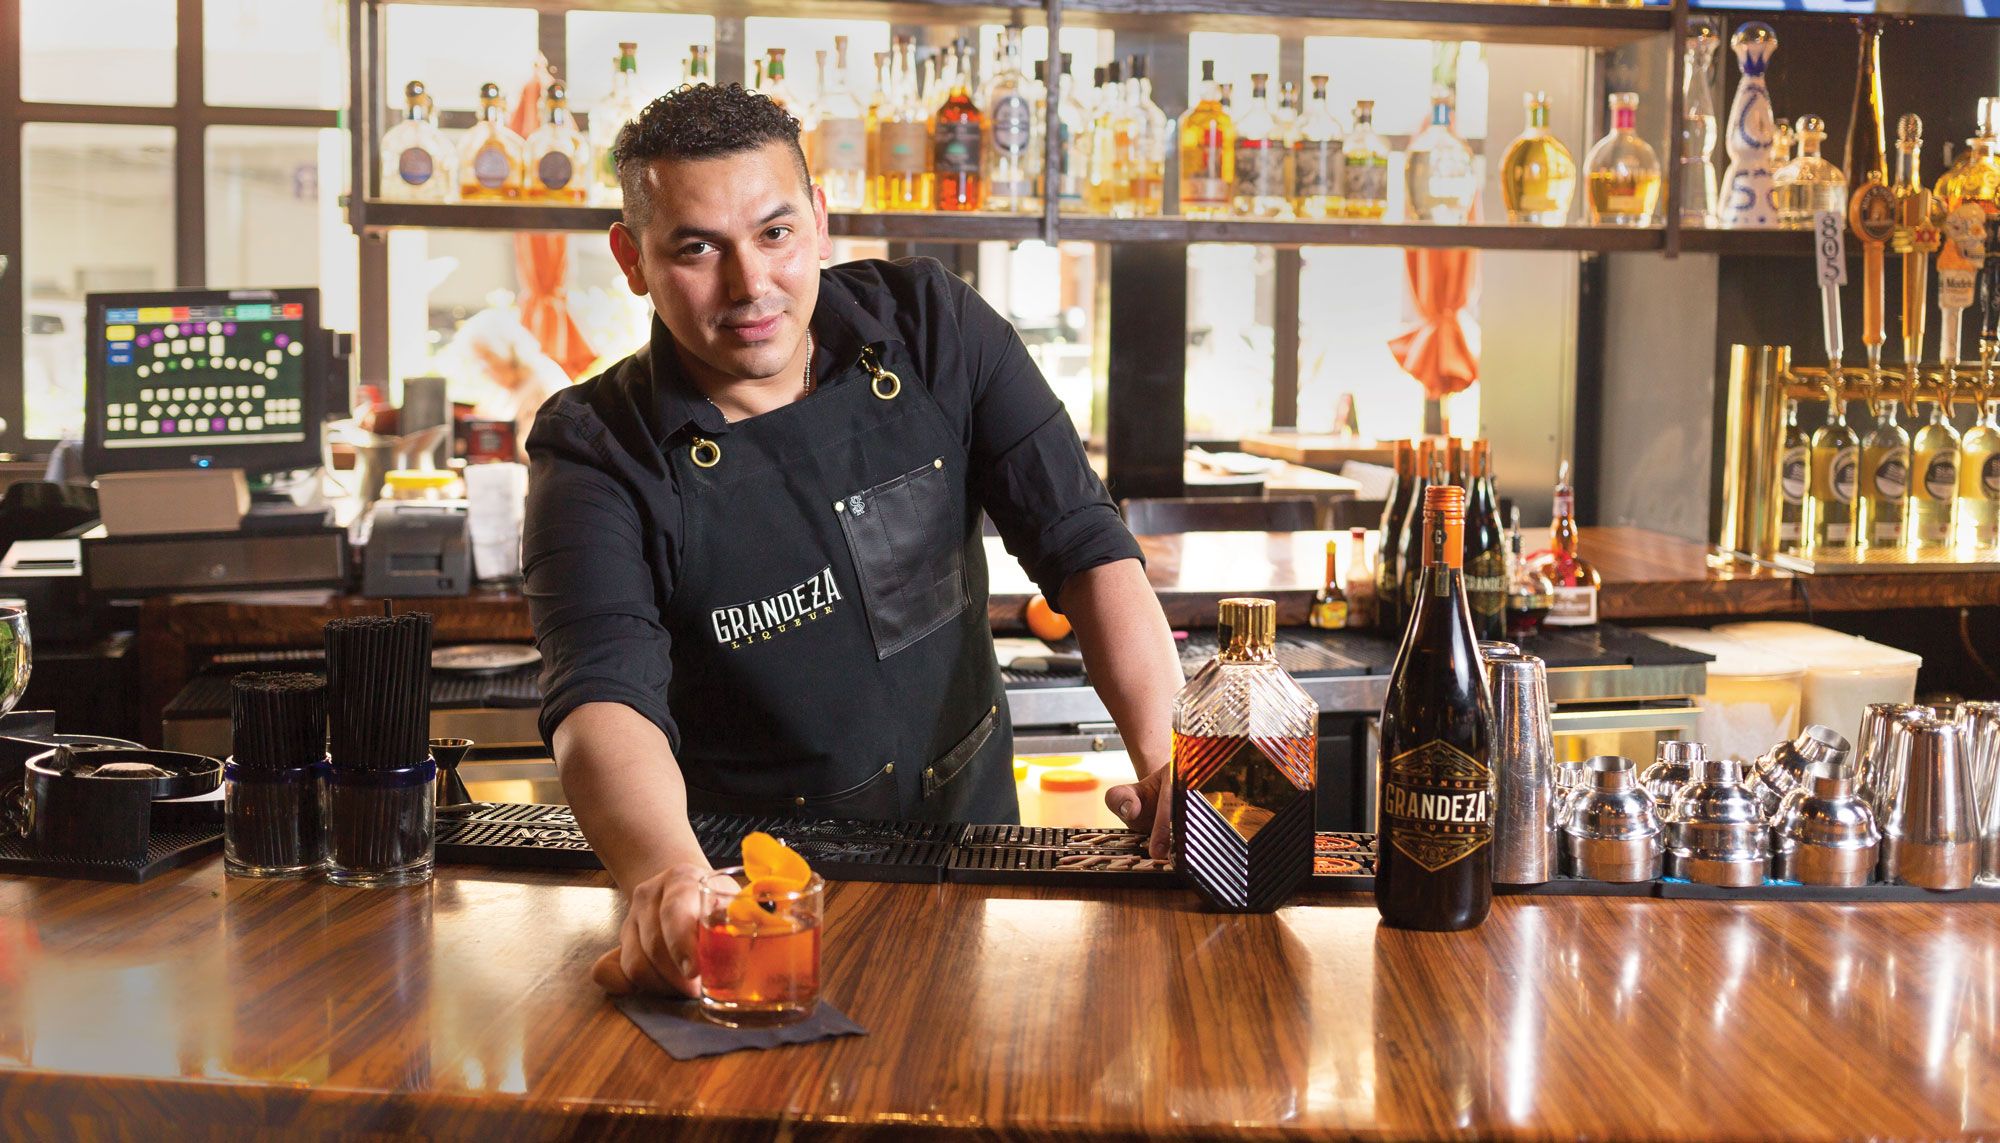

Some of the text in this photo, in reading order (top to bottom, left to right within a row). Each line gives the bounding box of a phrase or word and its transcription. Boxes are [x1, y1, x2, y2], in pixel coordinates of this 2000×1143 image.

[711, 567, 842, 644] GRANDEZA
[731, 606, 833, 650] LIQUEUR
[1385, 782, 1487, 822] GRANDEZA
